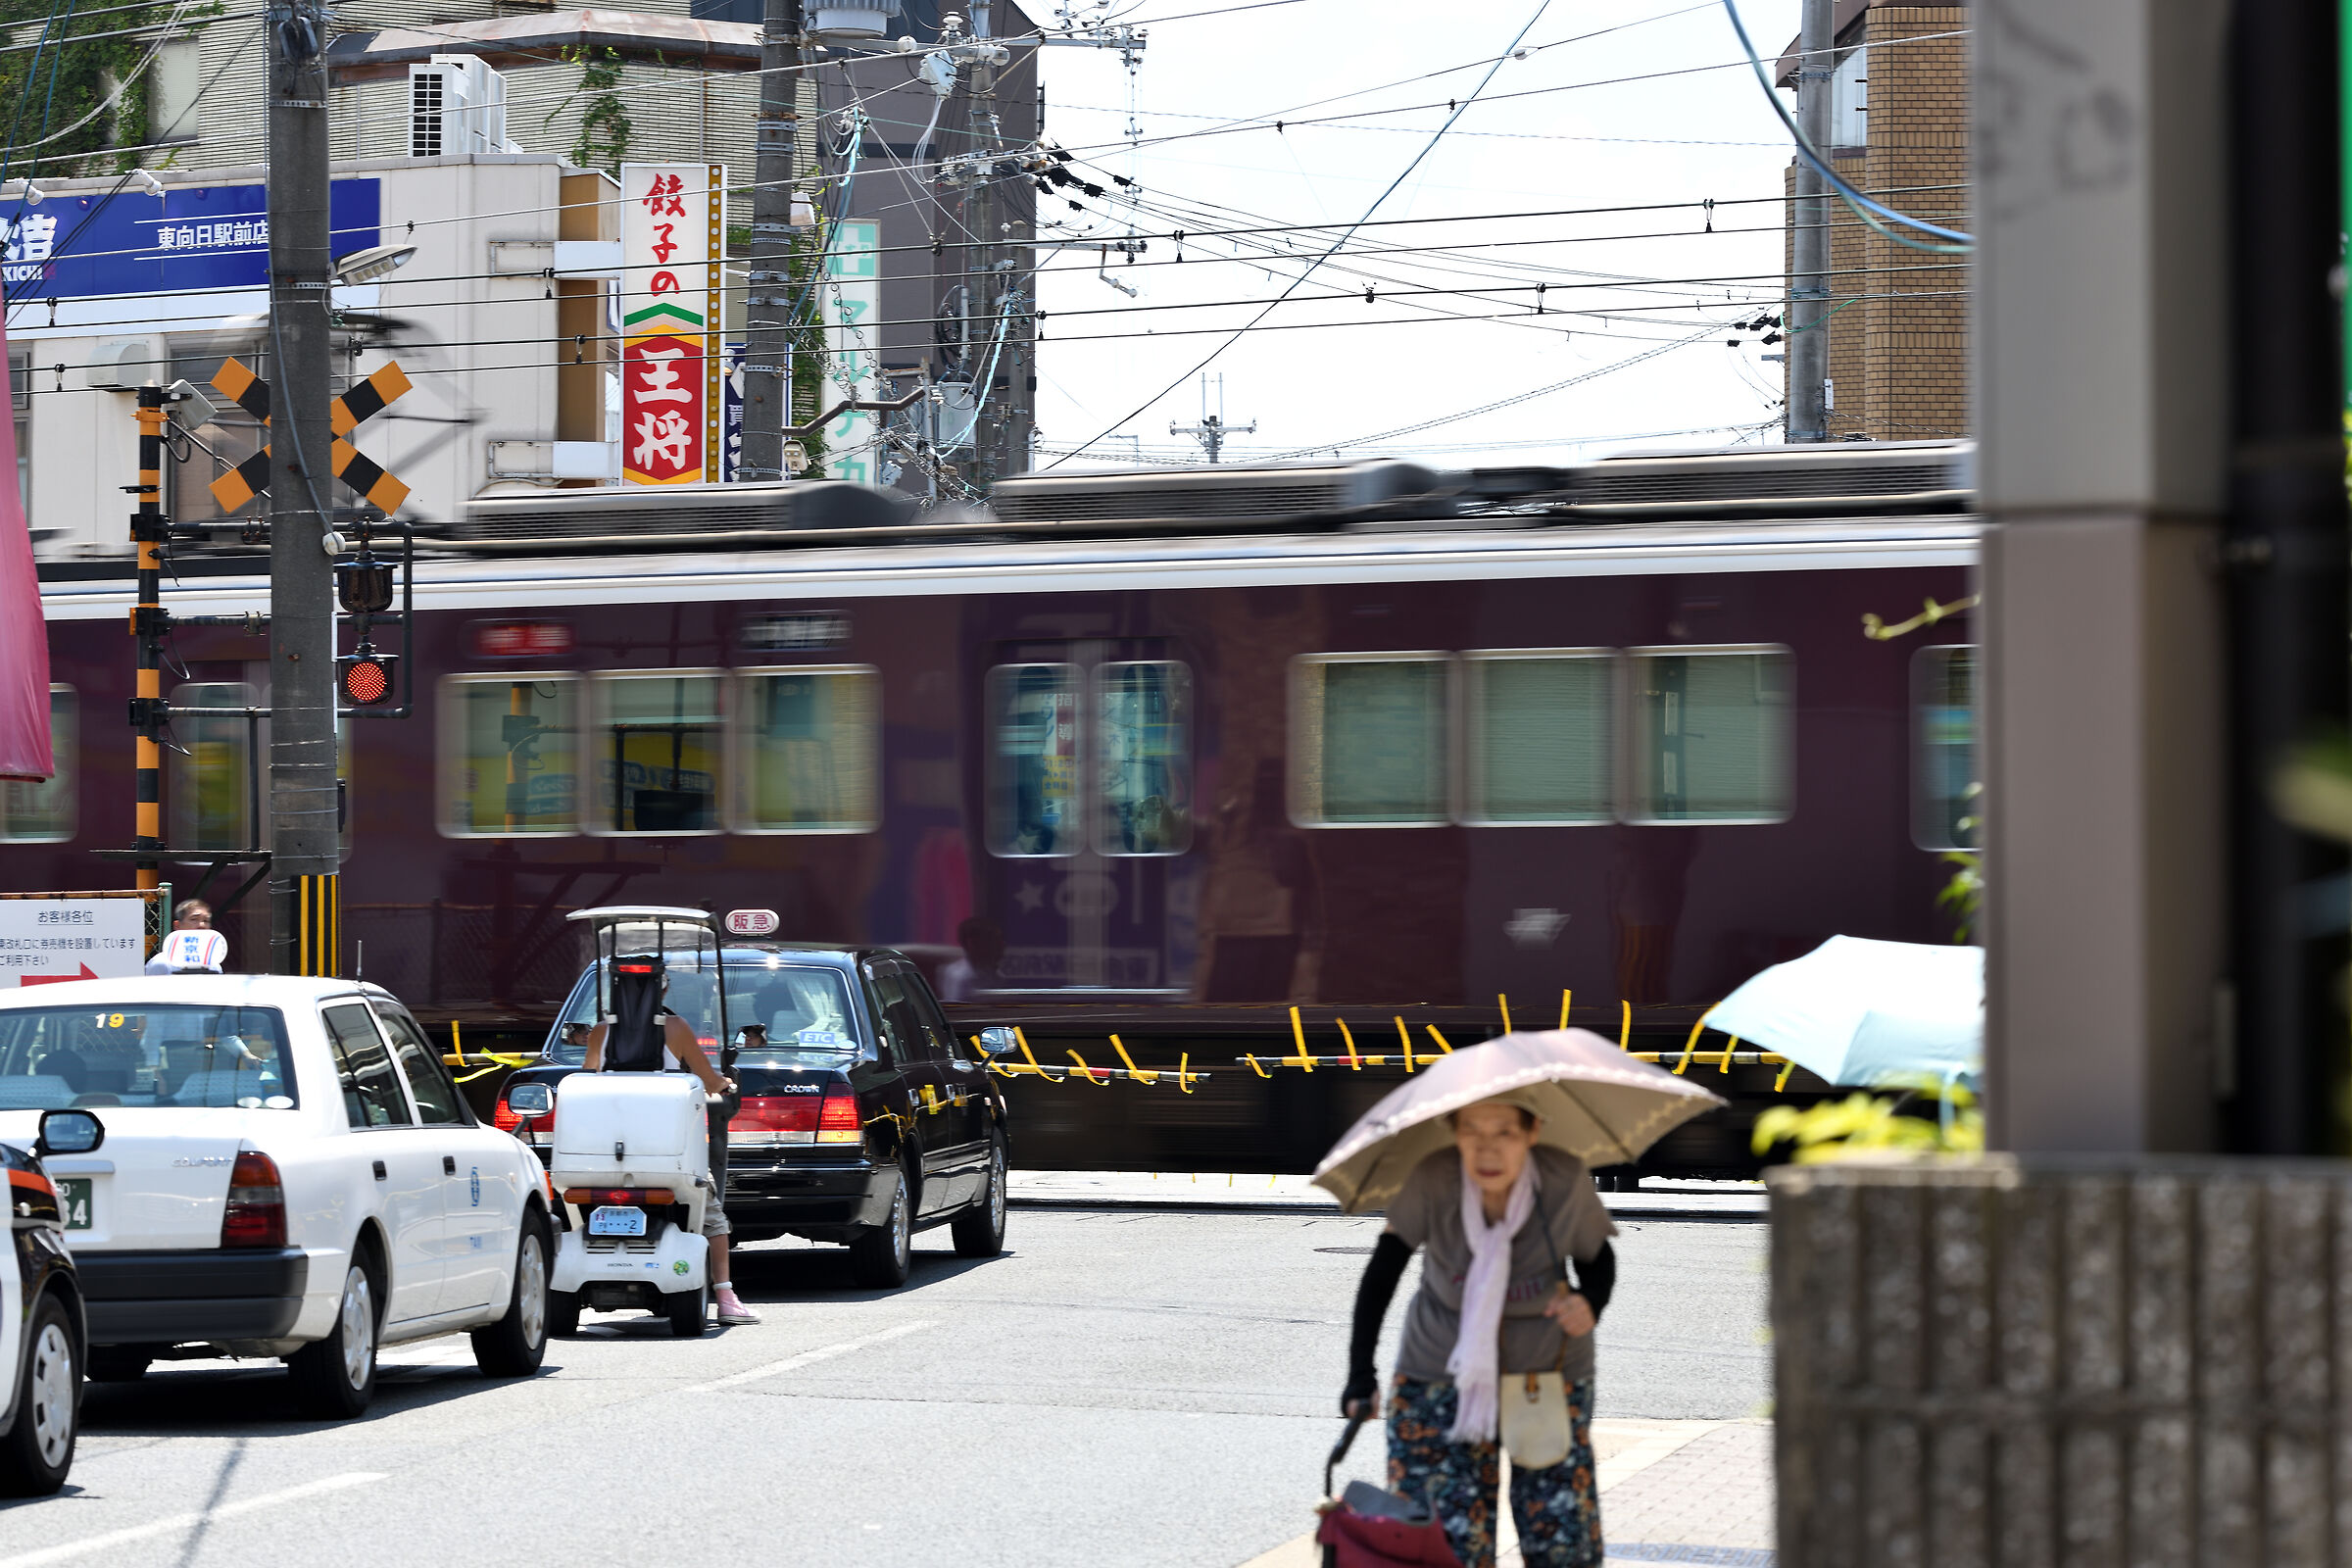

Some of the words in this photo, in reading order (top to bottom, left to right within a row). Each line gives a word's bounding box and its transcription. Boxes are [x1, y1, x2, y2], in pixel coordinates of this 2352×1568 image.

[157, 220, 270, 251] 東向日駅前店
[632, 173, 693, 470] 餃子の王将
[38, 909, 93, 923] お客様各位
[733, 914, 770, 930] 阪急
[95, 1012, 124, 1028] 19
[803, 1032, 832, 1044] ETC
[784, 1084, 820, 1093] CROWN
